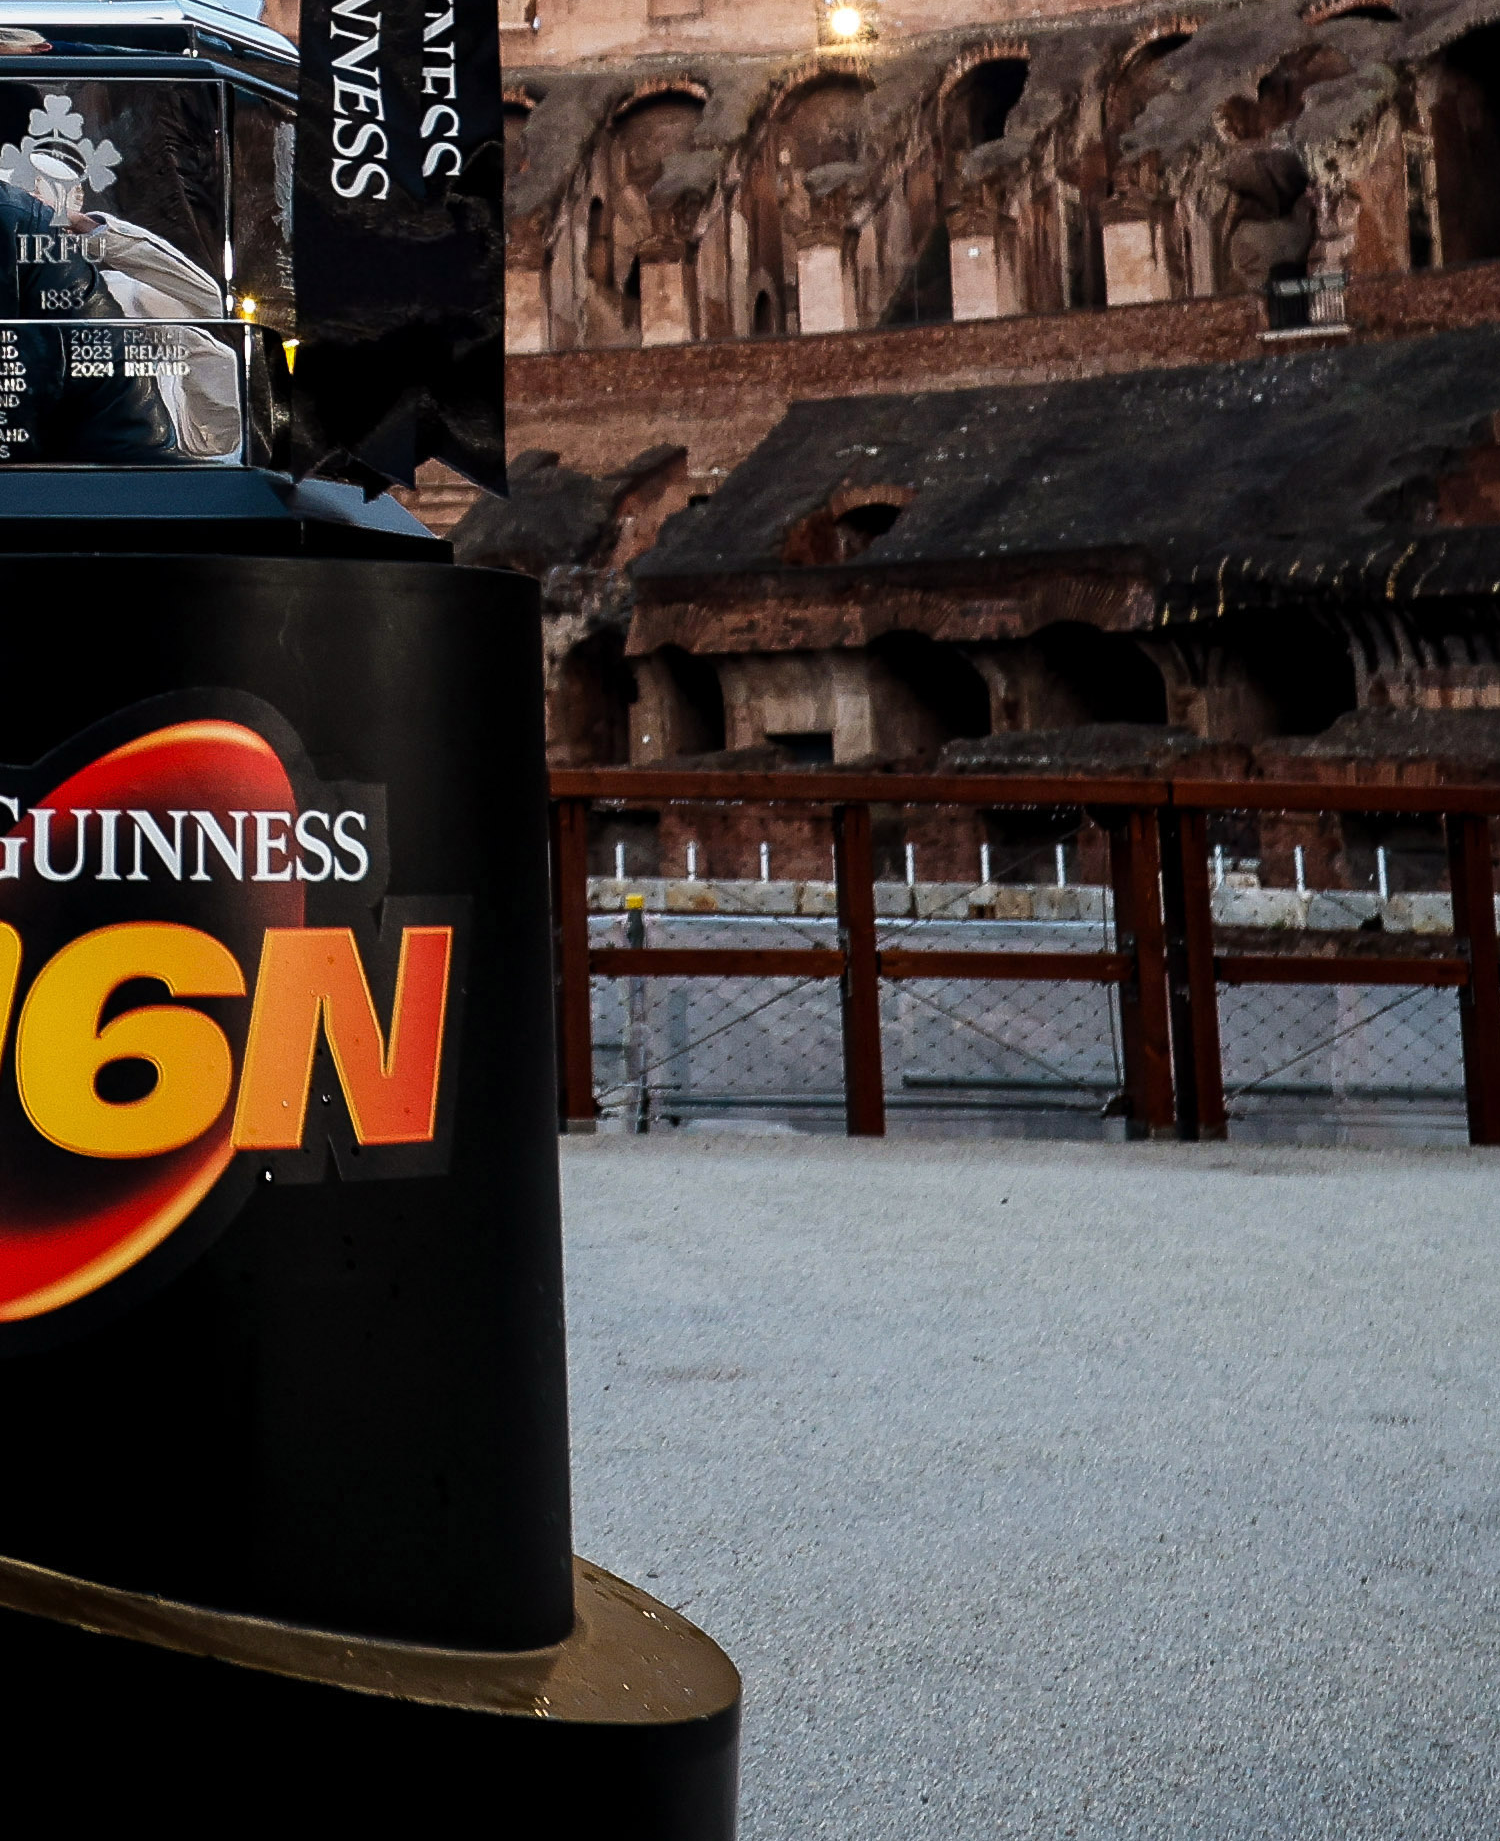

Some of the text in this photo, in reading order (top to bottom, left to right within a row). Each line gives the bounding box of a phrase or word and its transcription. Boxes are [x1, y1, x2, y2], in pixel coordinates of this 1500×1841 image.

[17, 233, 106, 264] IRFU
[40, 289, 85, 309] 1883
[70, 329, 112, 344] 2022
[71, 345, 190, 360] 2023 IRELAND
[70, 361, 191, 378] 2024 IRELAND
